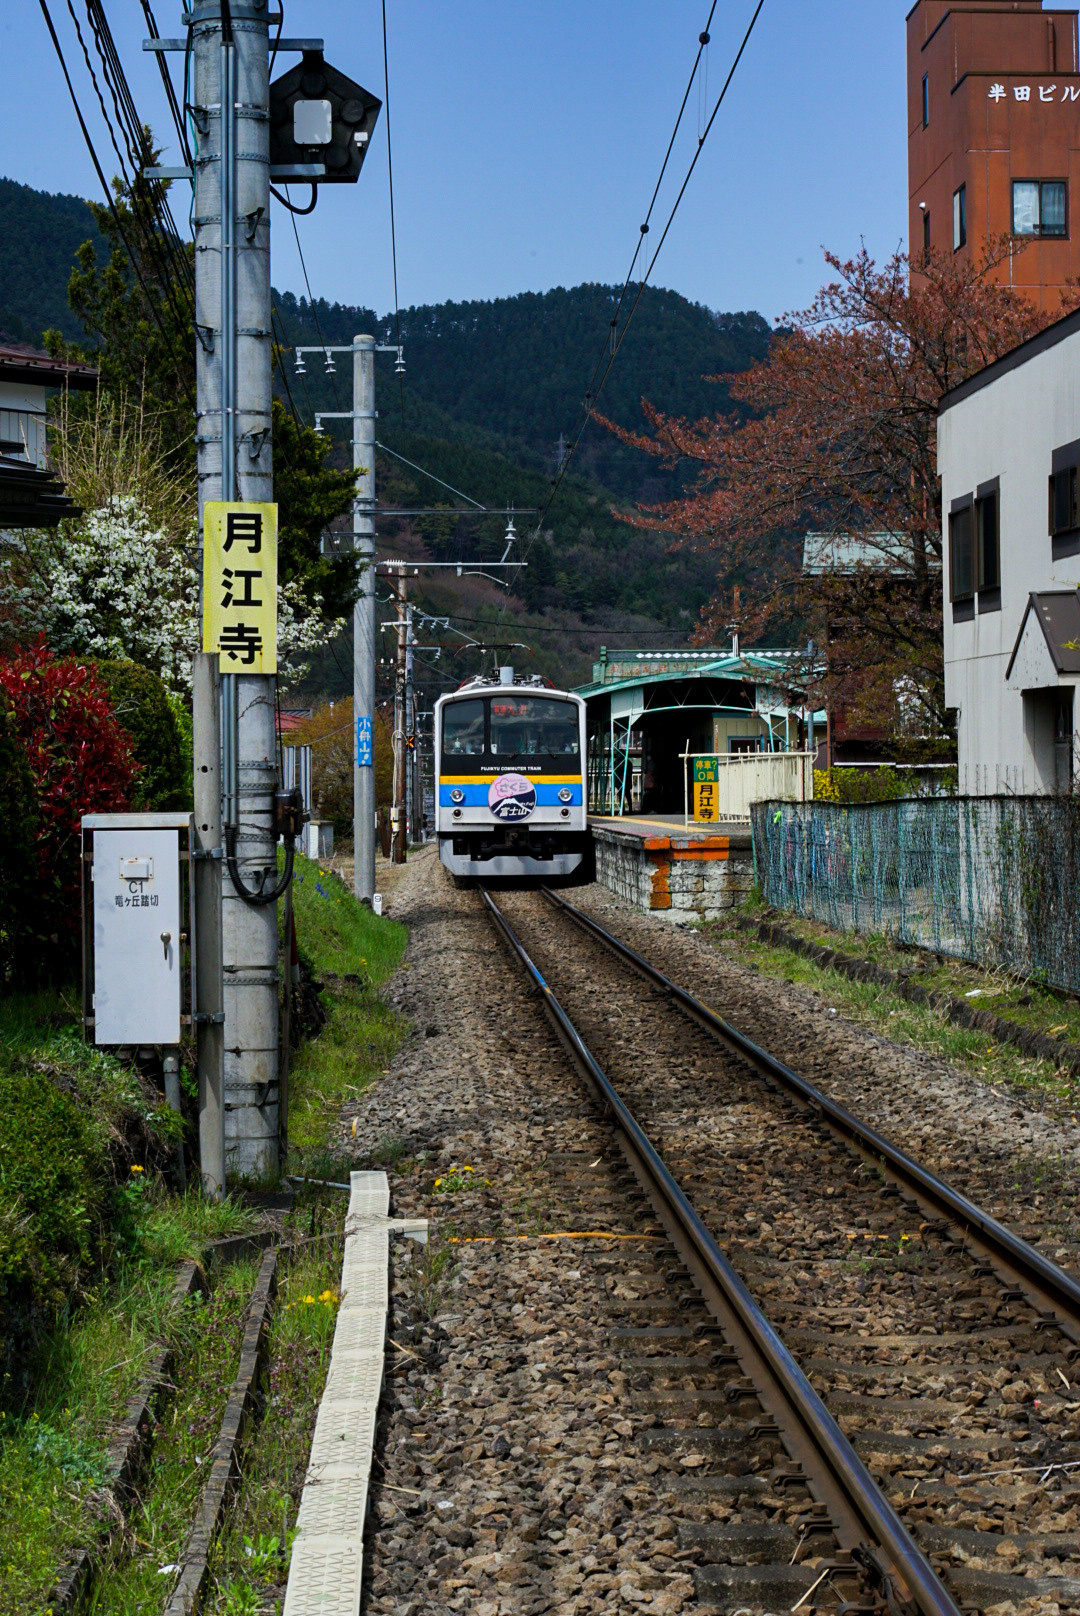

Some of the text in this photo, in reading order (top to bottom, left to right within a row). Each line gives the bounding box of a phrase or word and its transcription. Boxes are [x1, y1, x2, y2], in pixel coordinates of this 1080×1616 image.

[988, 83, 1080, 103] 半田ビル
[220, 512, 263, 665] 月江寺
[500, 782, 527, 793] さくら
[699, 784, 713, 819] 月江寺
[500, 806, 526, 817] 富士山
[129, 880, 143, 893] C1
